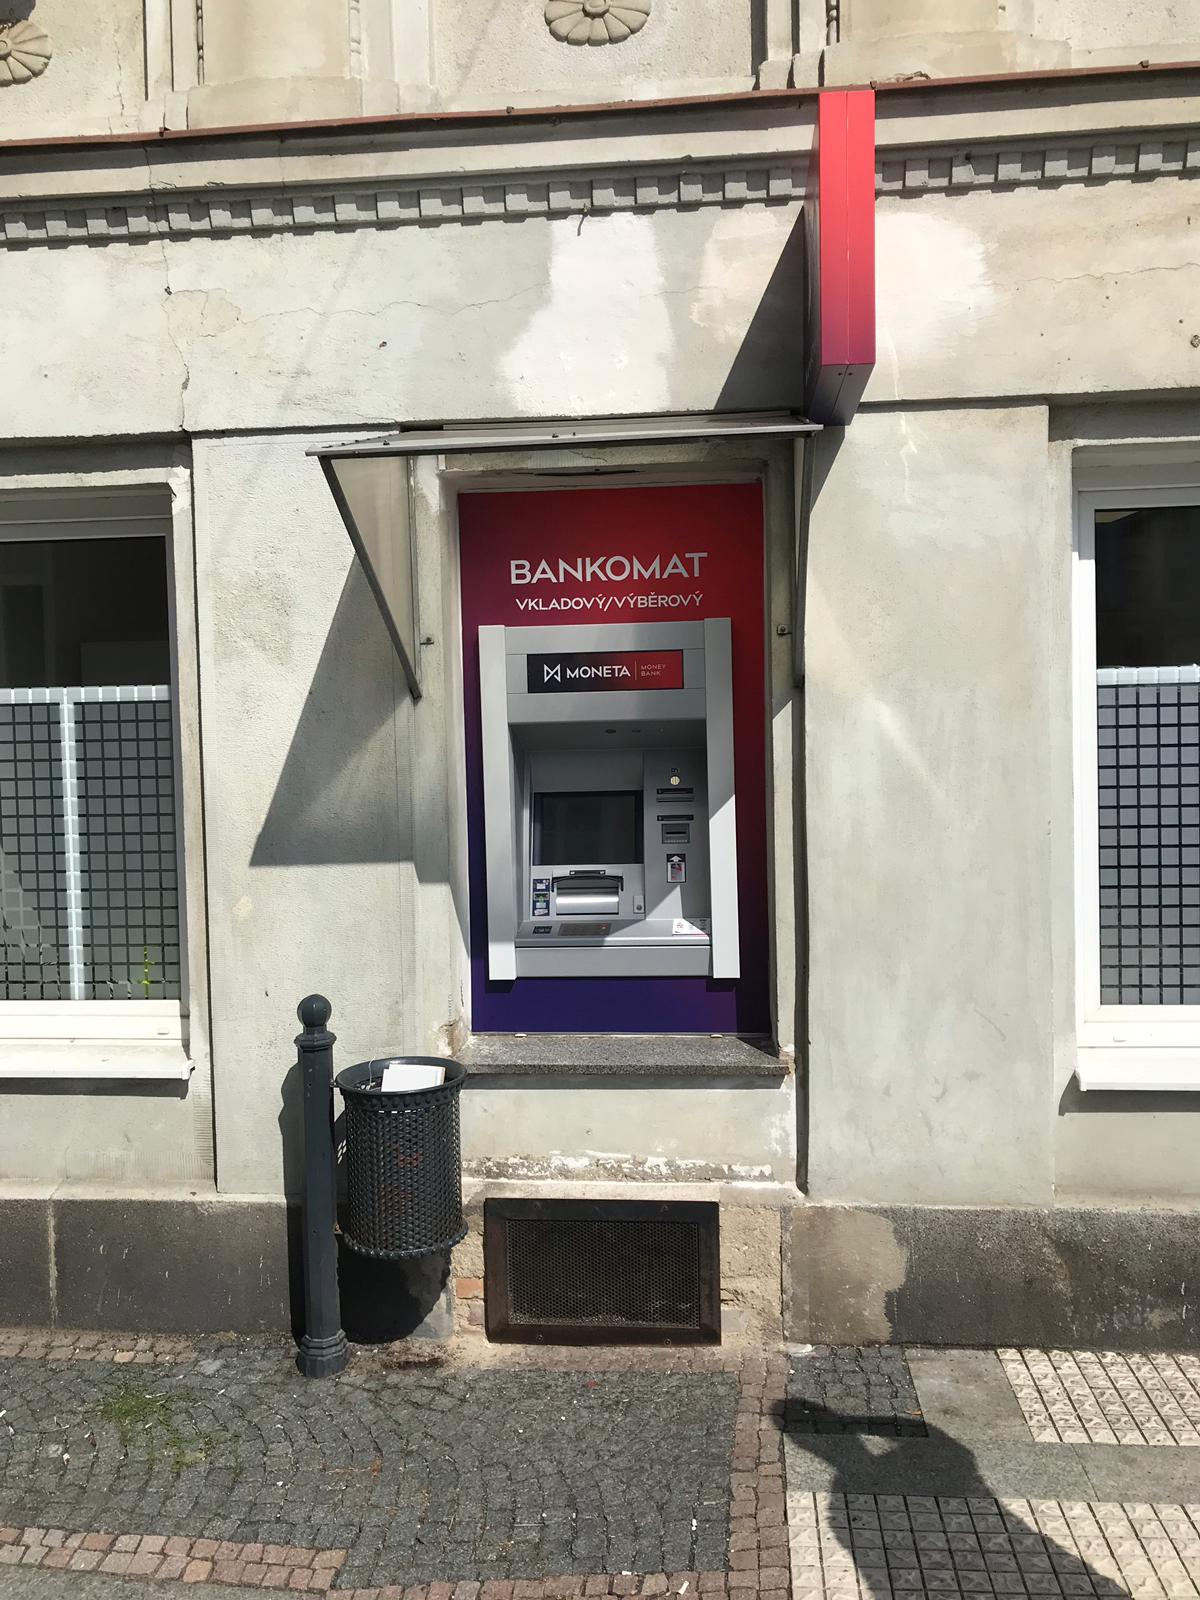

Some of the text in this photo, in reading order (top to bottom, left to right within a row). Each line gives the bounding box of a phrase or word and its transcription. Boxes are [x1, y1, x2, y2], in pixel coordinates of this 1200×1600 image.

[510, 552, 708, 585] BANKOMAT
[515, 590, 704, 611] VKLADOVÝ/VÝBĚROVÝ
[566, 665, 631, 679] MONETA
[640, 663, 666, 671] MONEY
